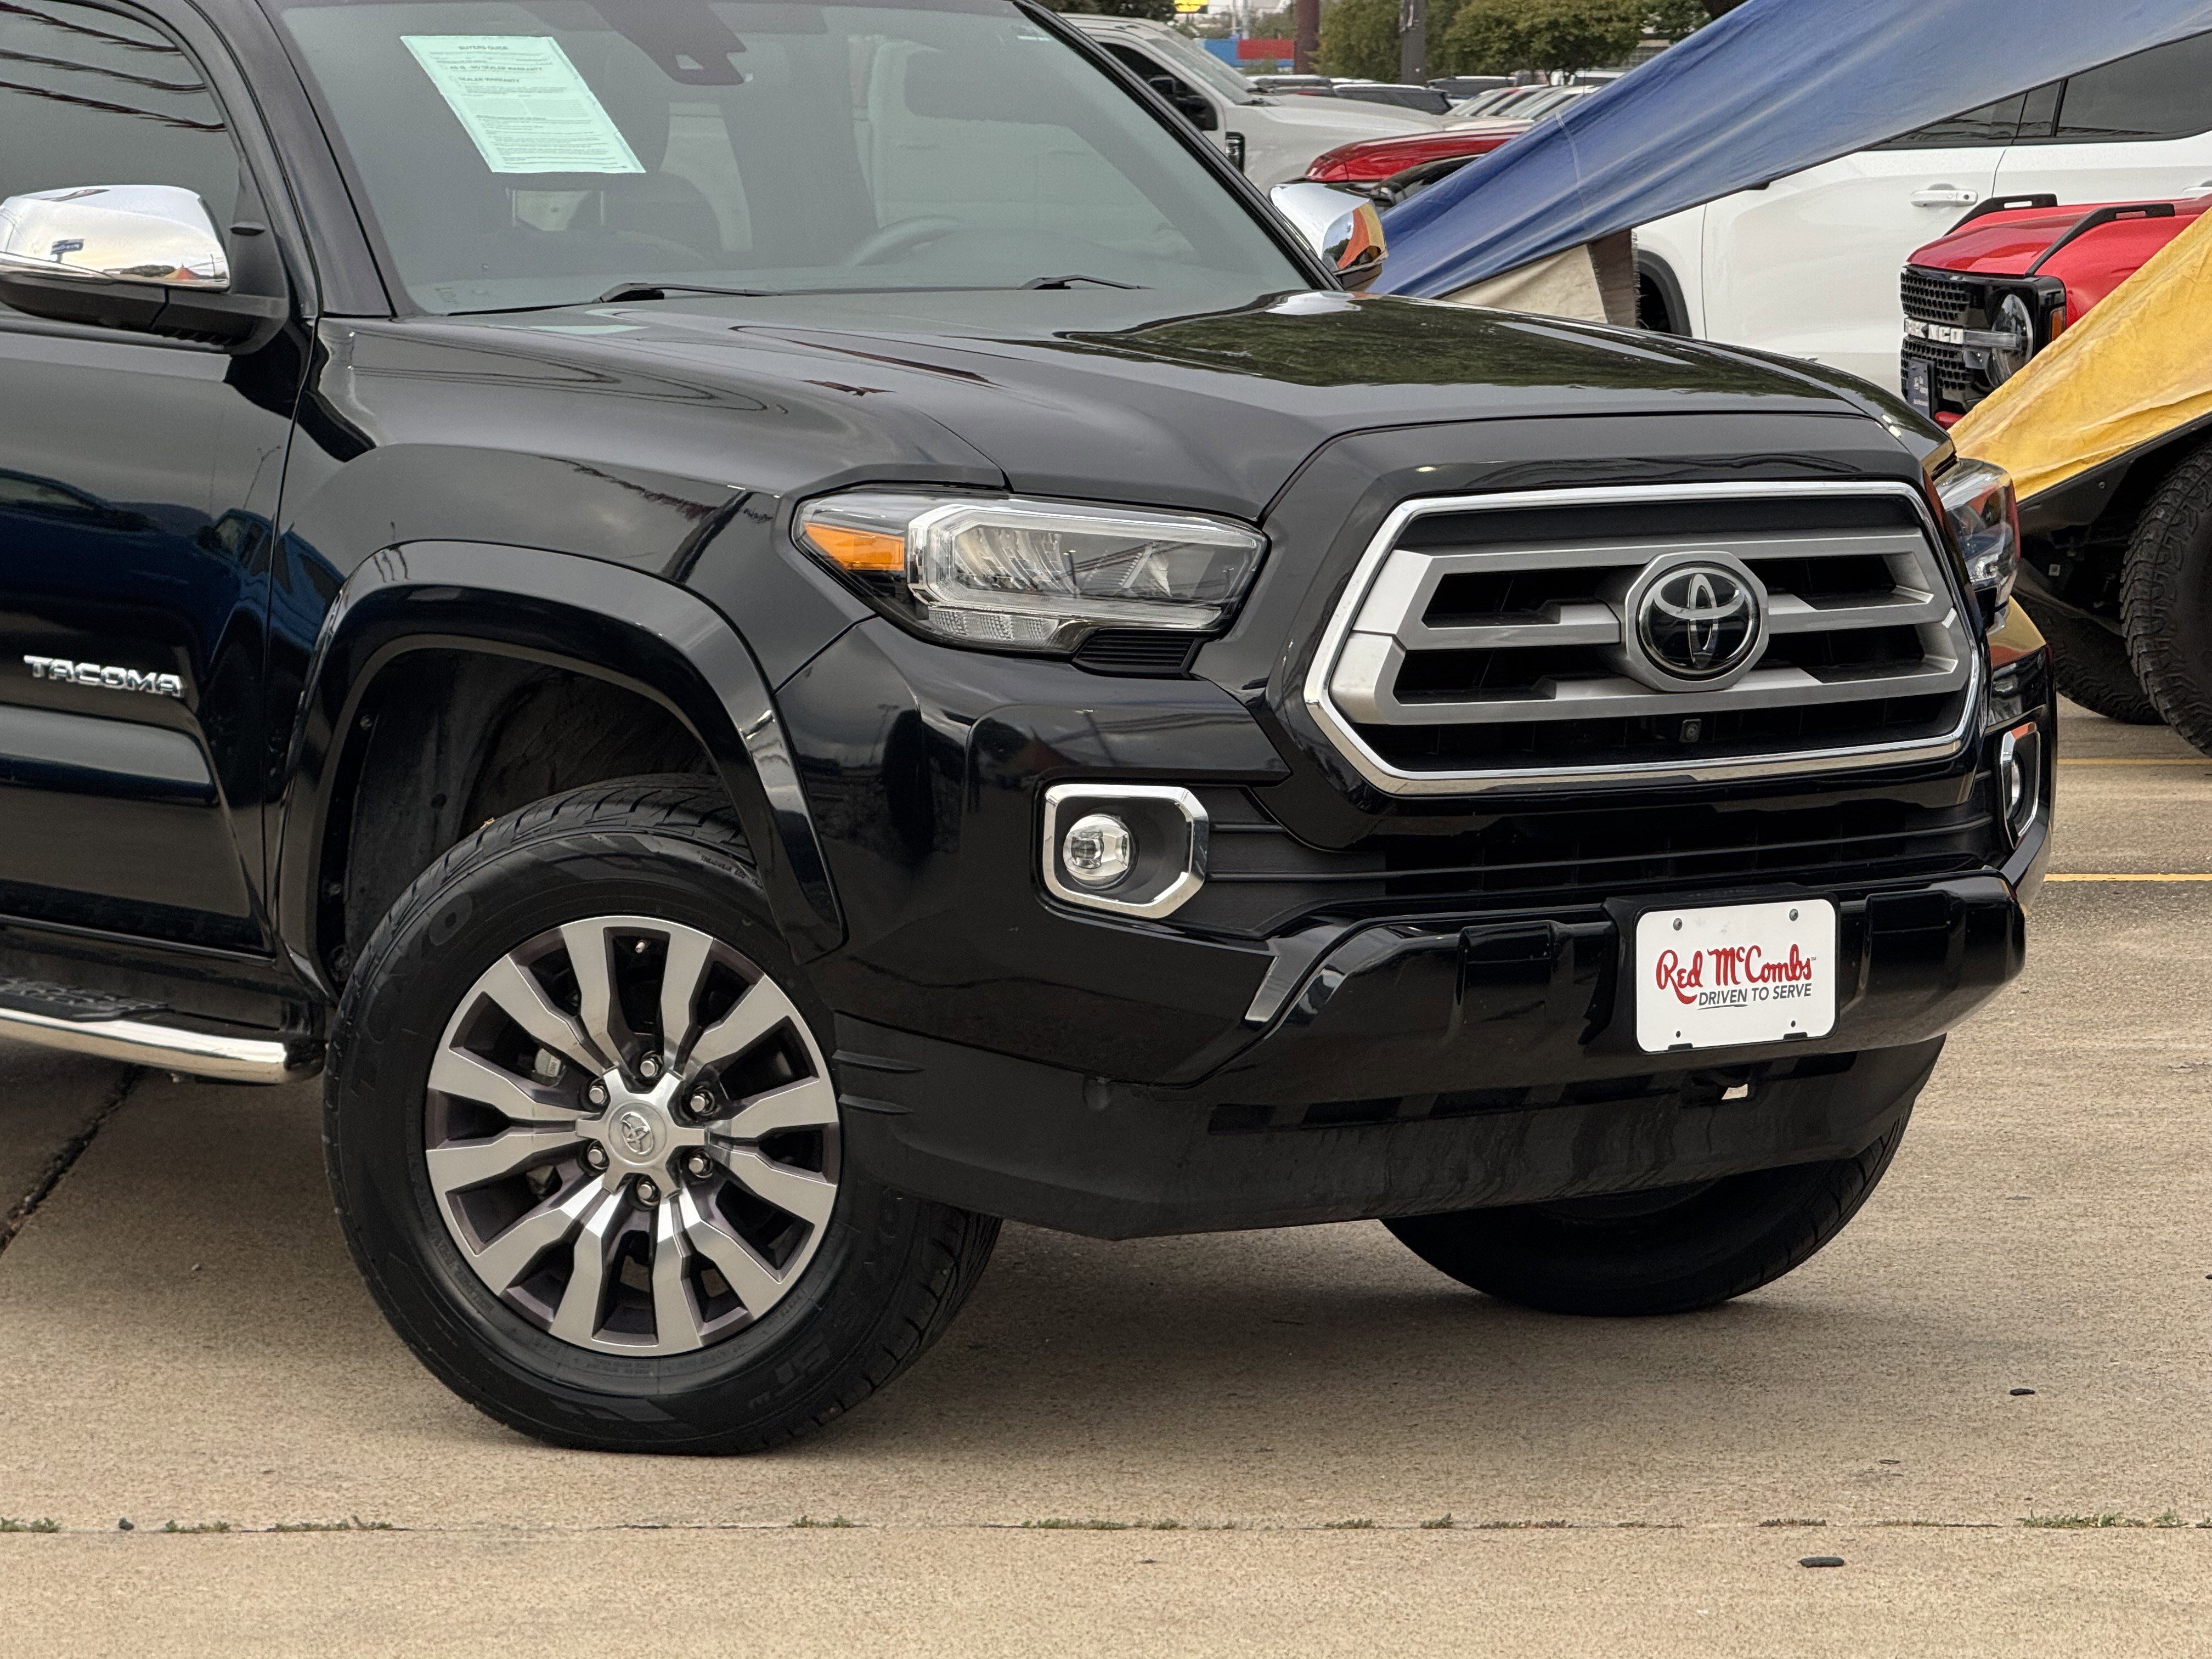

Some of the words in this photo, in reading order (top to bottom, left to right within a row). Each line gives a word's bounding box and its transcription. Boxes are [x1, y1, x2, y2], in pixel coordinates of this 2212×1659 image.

[24, 655, 183, 697] TACOMA
[1656, 949, 1703, 1005] Red
[1707, 944, 1812, 986] McCombs
[1699, 989, 1747, 1006] DRIVEN
[1752, 986, 1769, 1002] TO
[1773, 983, 1812, 1000] SERVE
